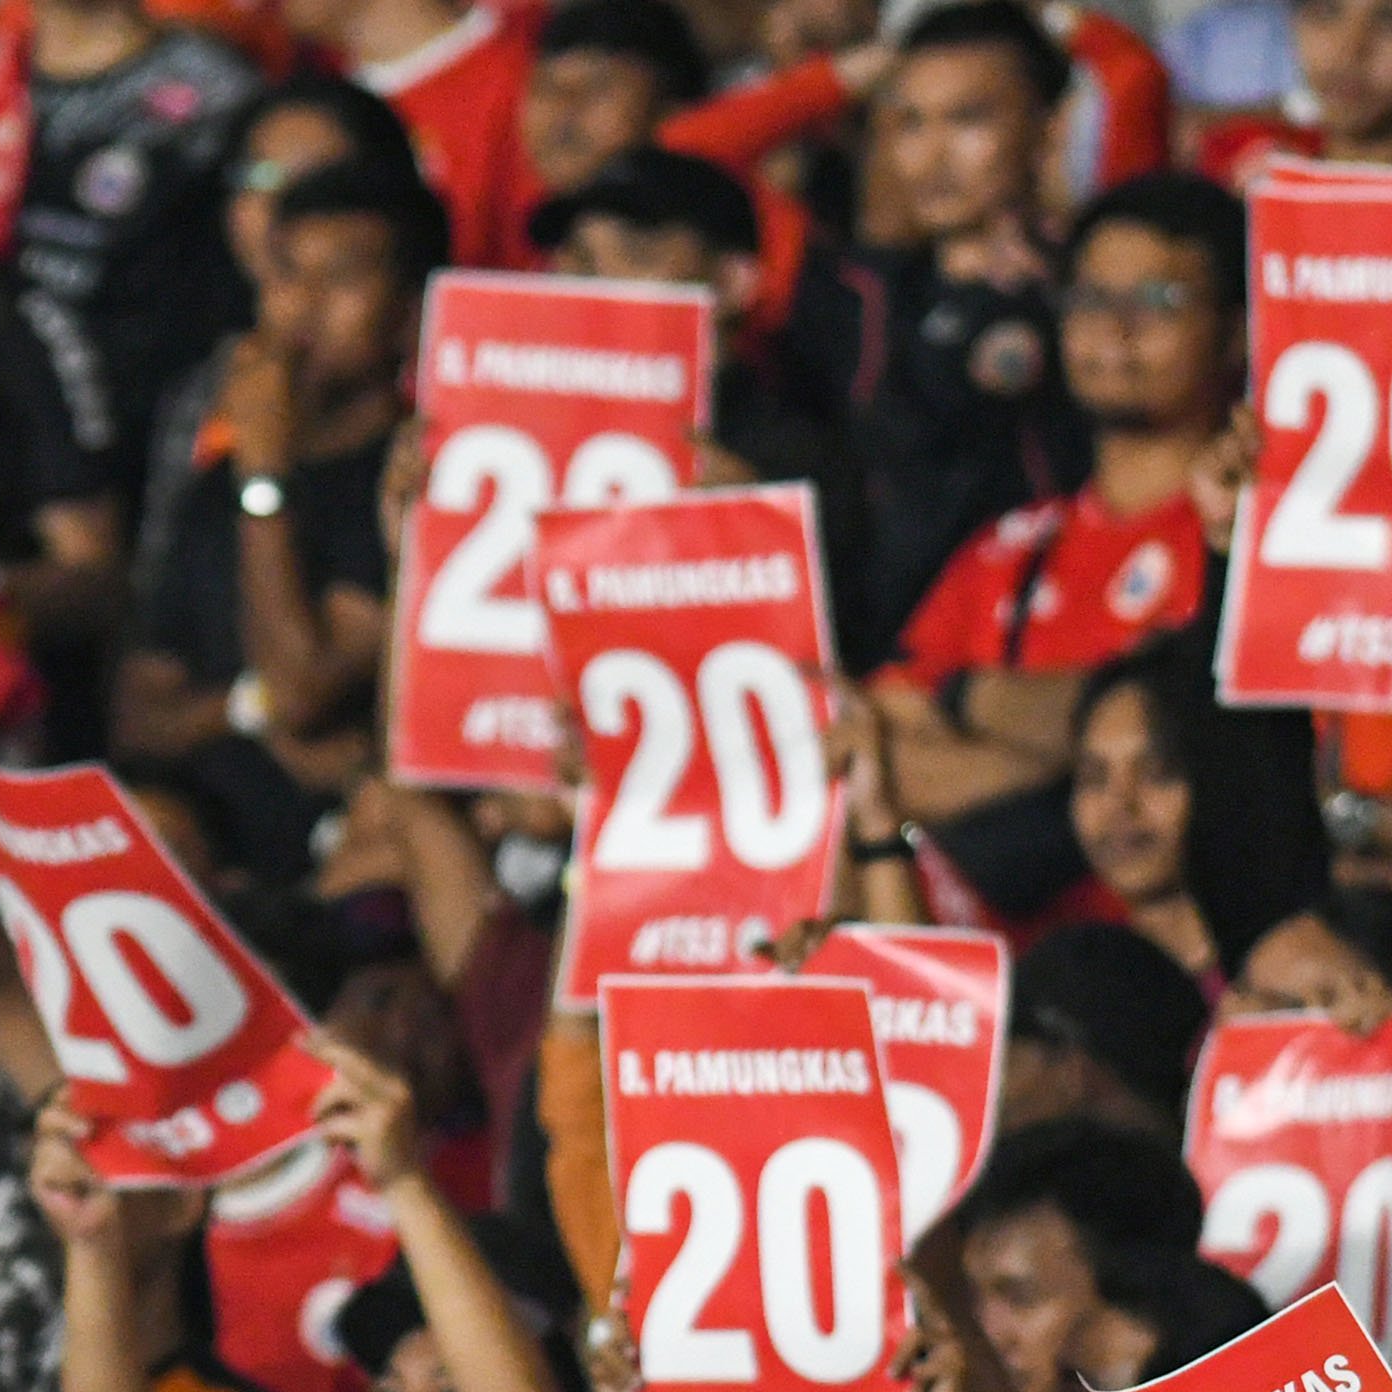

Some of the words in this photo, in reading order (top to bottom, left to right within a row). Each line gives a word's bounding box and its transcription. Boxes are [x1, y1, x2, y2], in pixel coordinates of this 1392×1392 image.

[578, 640, 827, 872] 20
[619, 1050, 651, 1095] B.
[655, 1049, 871, 1096] PAMUNGKAS
[625, 1136, 885, 1385] 20
